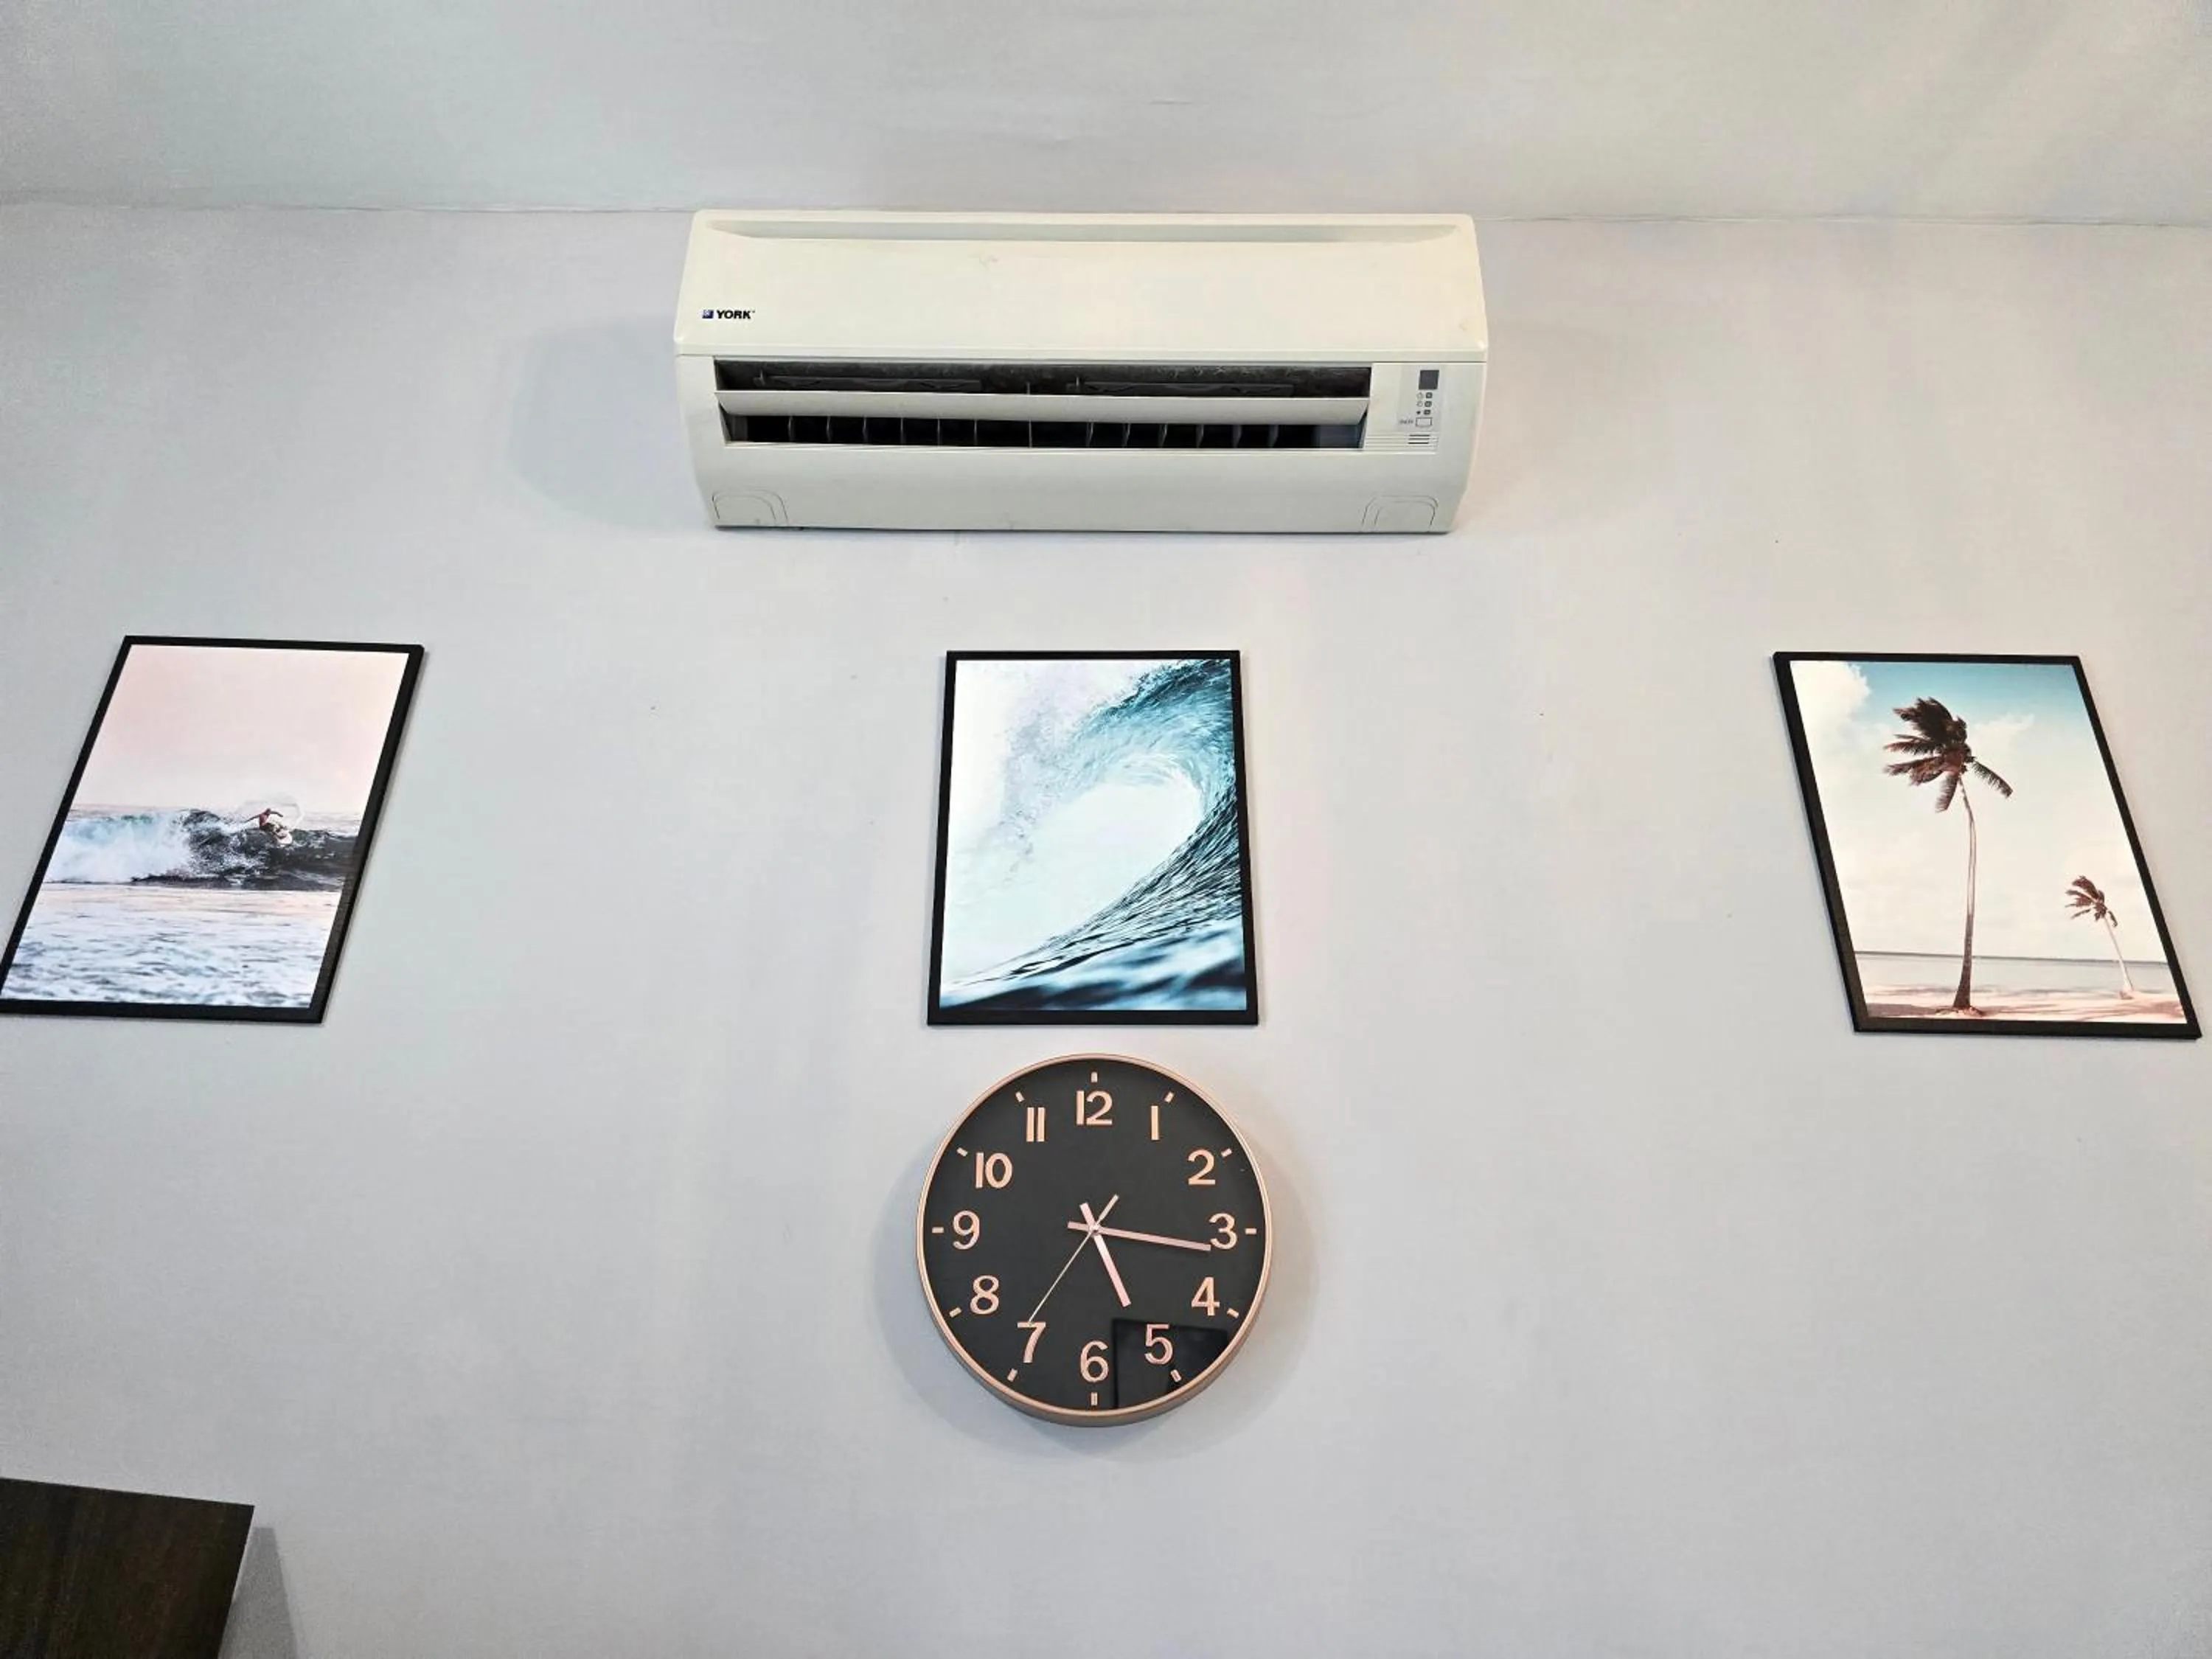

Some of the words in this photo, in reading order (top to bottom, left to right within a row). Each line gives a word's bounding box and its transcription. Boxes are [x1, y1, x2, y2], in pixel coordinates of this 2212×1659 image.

[716, 309, 751, 319] YORK
[1026, 1107, 1046, 1142] 11
[1076, 1090, 1113, 1125] 12
[1150, 1105, 1159, 1141] 1
[975, 1152, 1012, 1189] 10
[1188, 1149, 1216, 1186] 2
[952, 1210, 980, 1250] 9
[1208, 1213, 1238, 1249] 3
[970, 1275, 1000, 1315] 8
[1191, 1276, 1220, 1316] 4
[1017, 1321, 1046, 1363] 7
[1144, 1324, 1174, 1365] 5
[1079, 1340, 1109, 1382] 6
